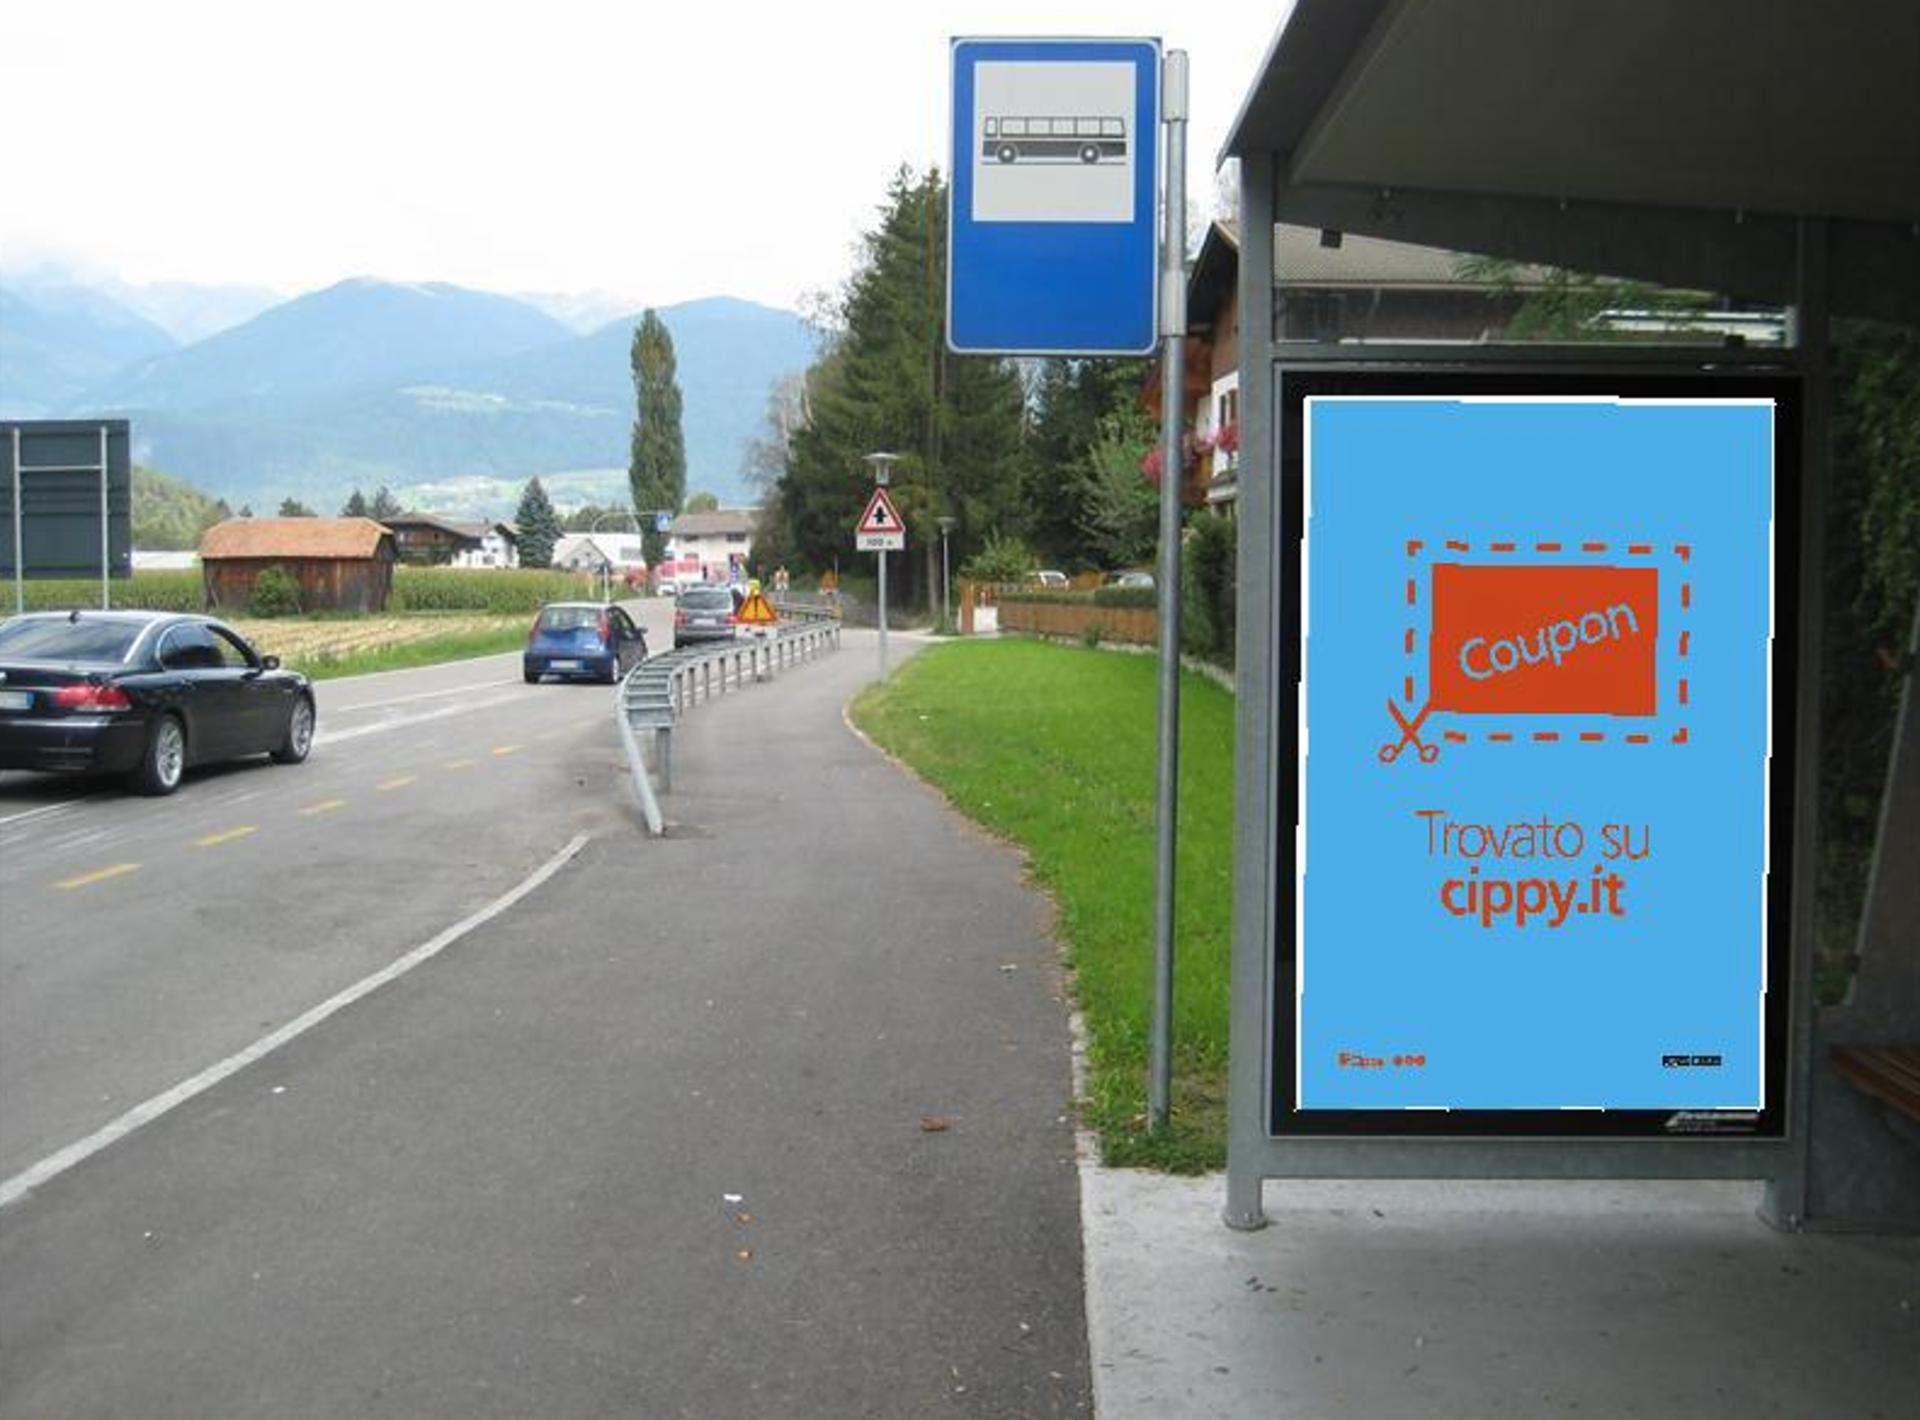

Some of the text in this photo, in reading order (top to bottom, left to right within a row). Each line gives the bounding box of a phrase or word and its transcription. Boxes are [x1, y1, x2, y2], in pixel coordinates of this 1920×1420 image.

[1460, 602, 1639, 680] Coupon
[1414, 810, 1649, 860] Trovato su
[1441, 863, 1625, 928] cippy.it
